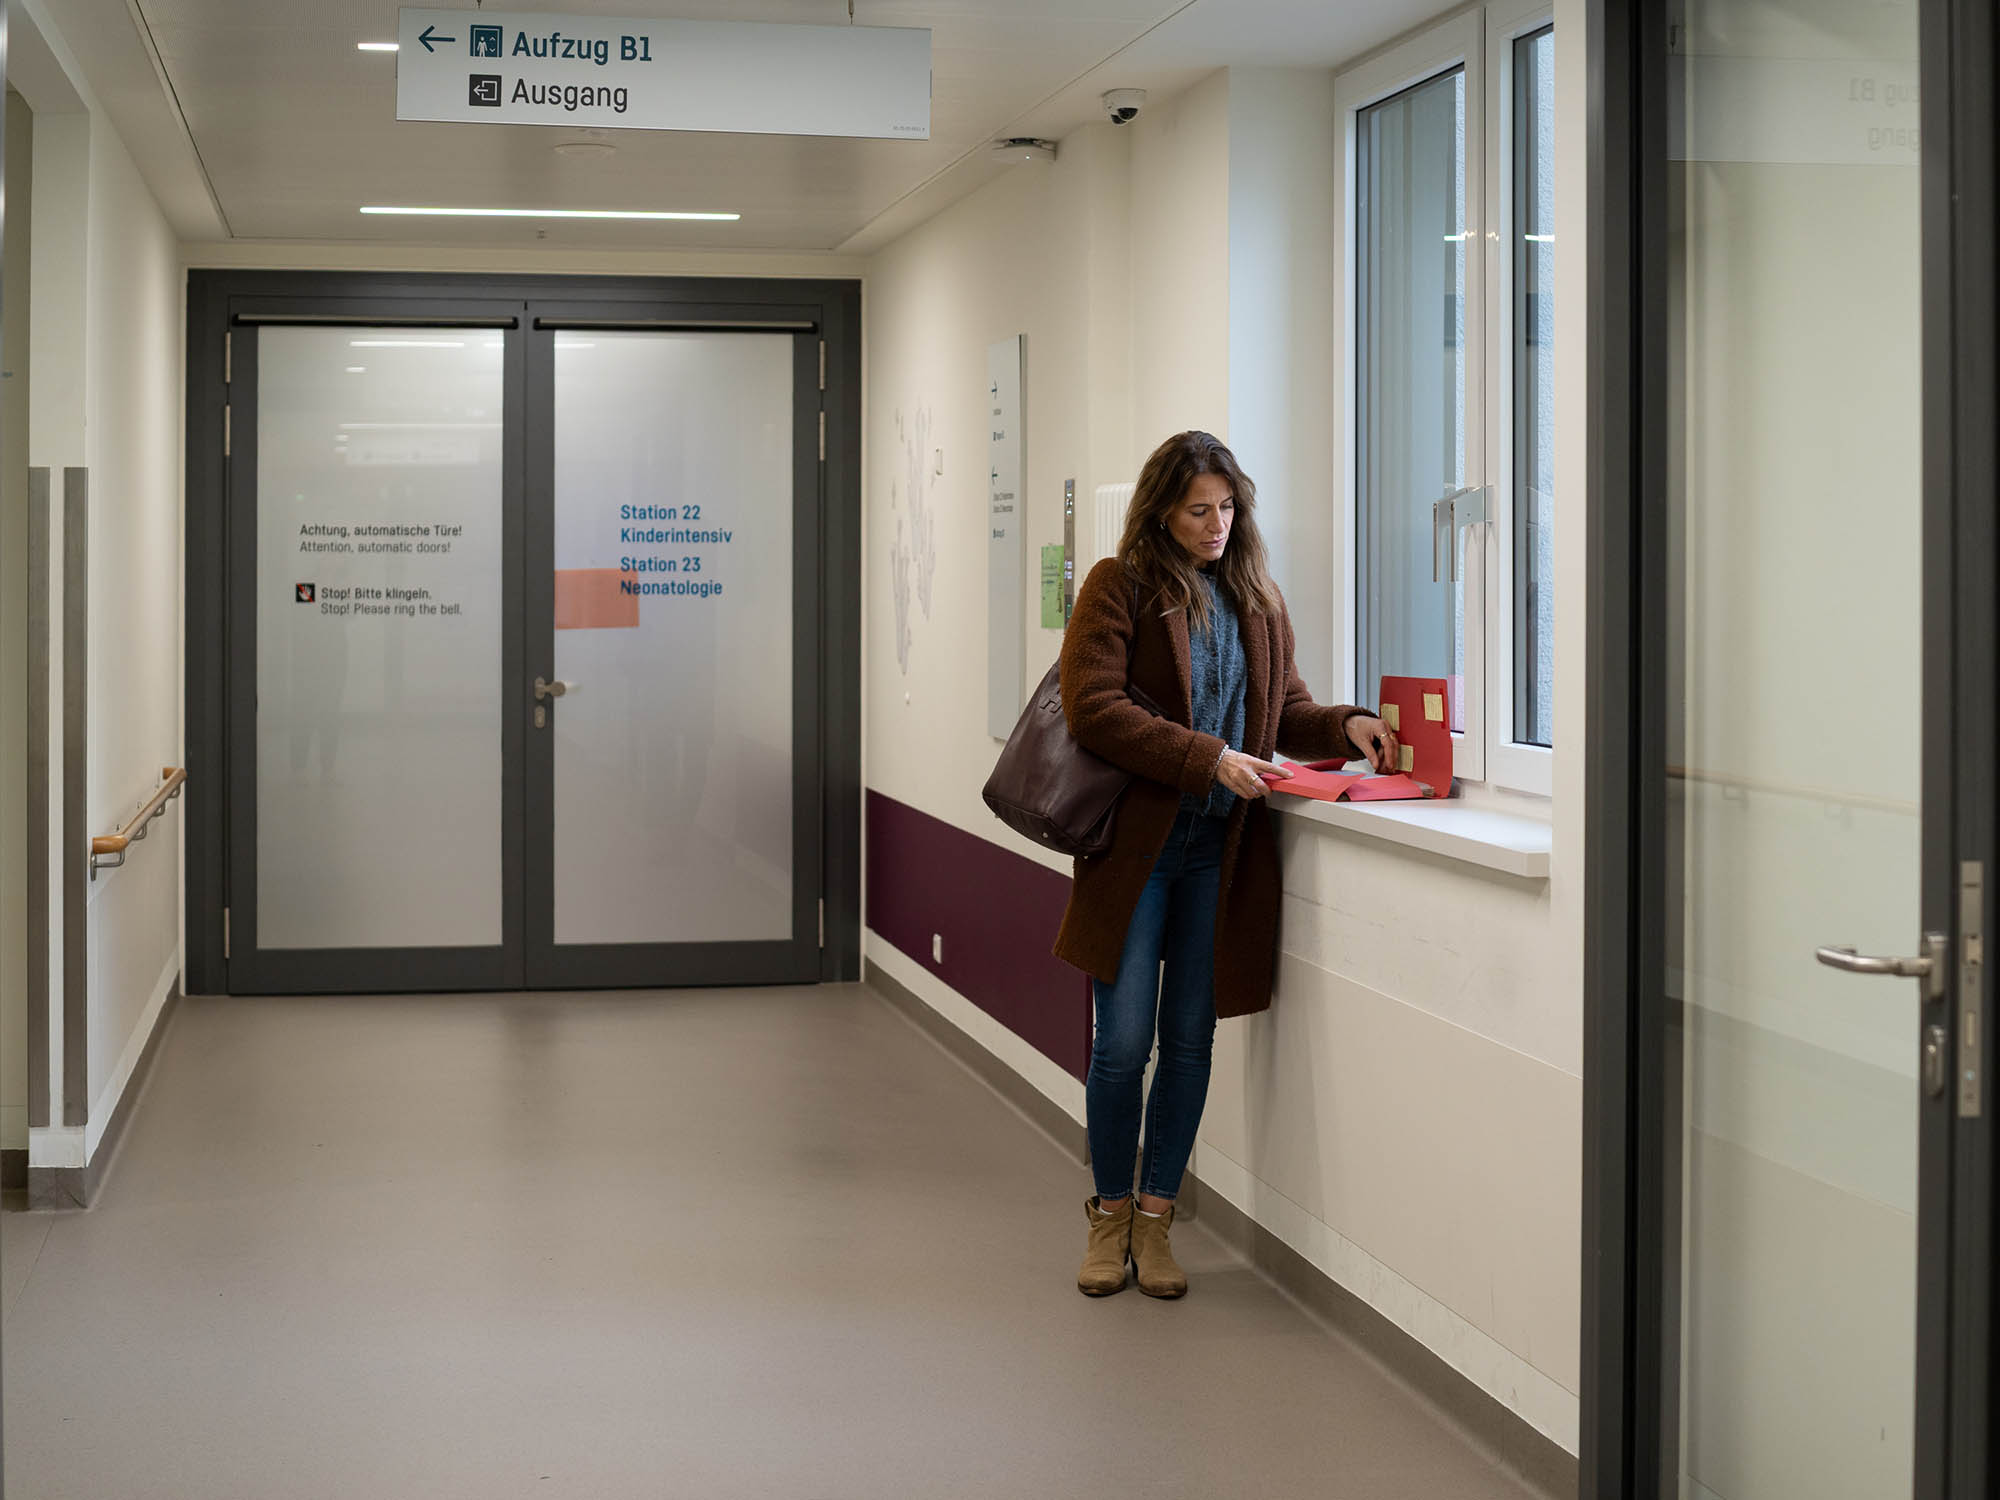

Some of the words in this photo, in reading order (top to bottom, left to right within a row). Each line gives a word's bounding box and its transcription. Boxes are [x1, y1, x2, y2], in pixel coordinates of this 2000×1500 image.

[512, 31, 609, 66] Aufzug
[620, 35, 652, 62] B1
[511, 78, 628, 114] Ausgang
[621, 504, 677, 521] Station
[682, 504, 701, 521] 22
[300, 524, 351, 539] Achtung,
[354, 525, 431, 537] automatische
[434, 523, 463, 537] Türe!
[620, 527, 733, 544] Kinderintensiv
[300, 541, 354, 553] Attention,
[357, 542, 412, 553] automatic
[416, 542, 451, 553] doors!
[620, 556, 677, 573] Station
[682, 556, 701, 573] 23
[321, 587, 350, 602] Stop!
[355, 587, 382, 600] Bitte
[620, 579, 723, 599] Neonatologie
[321, 602, 350, 617] Stop!
[354, 602, 391, 615] Please
[395, 603, 416, 617] ring
[419, 603, 437, 615] the
[440, 603, 463, 616] bell.
